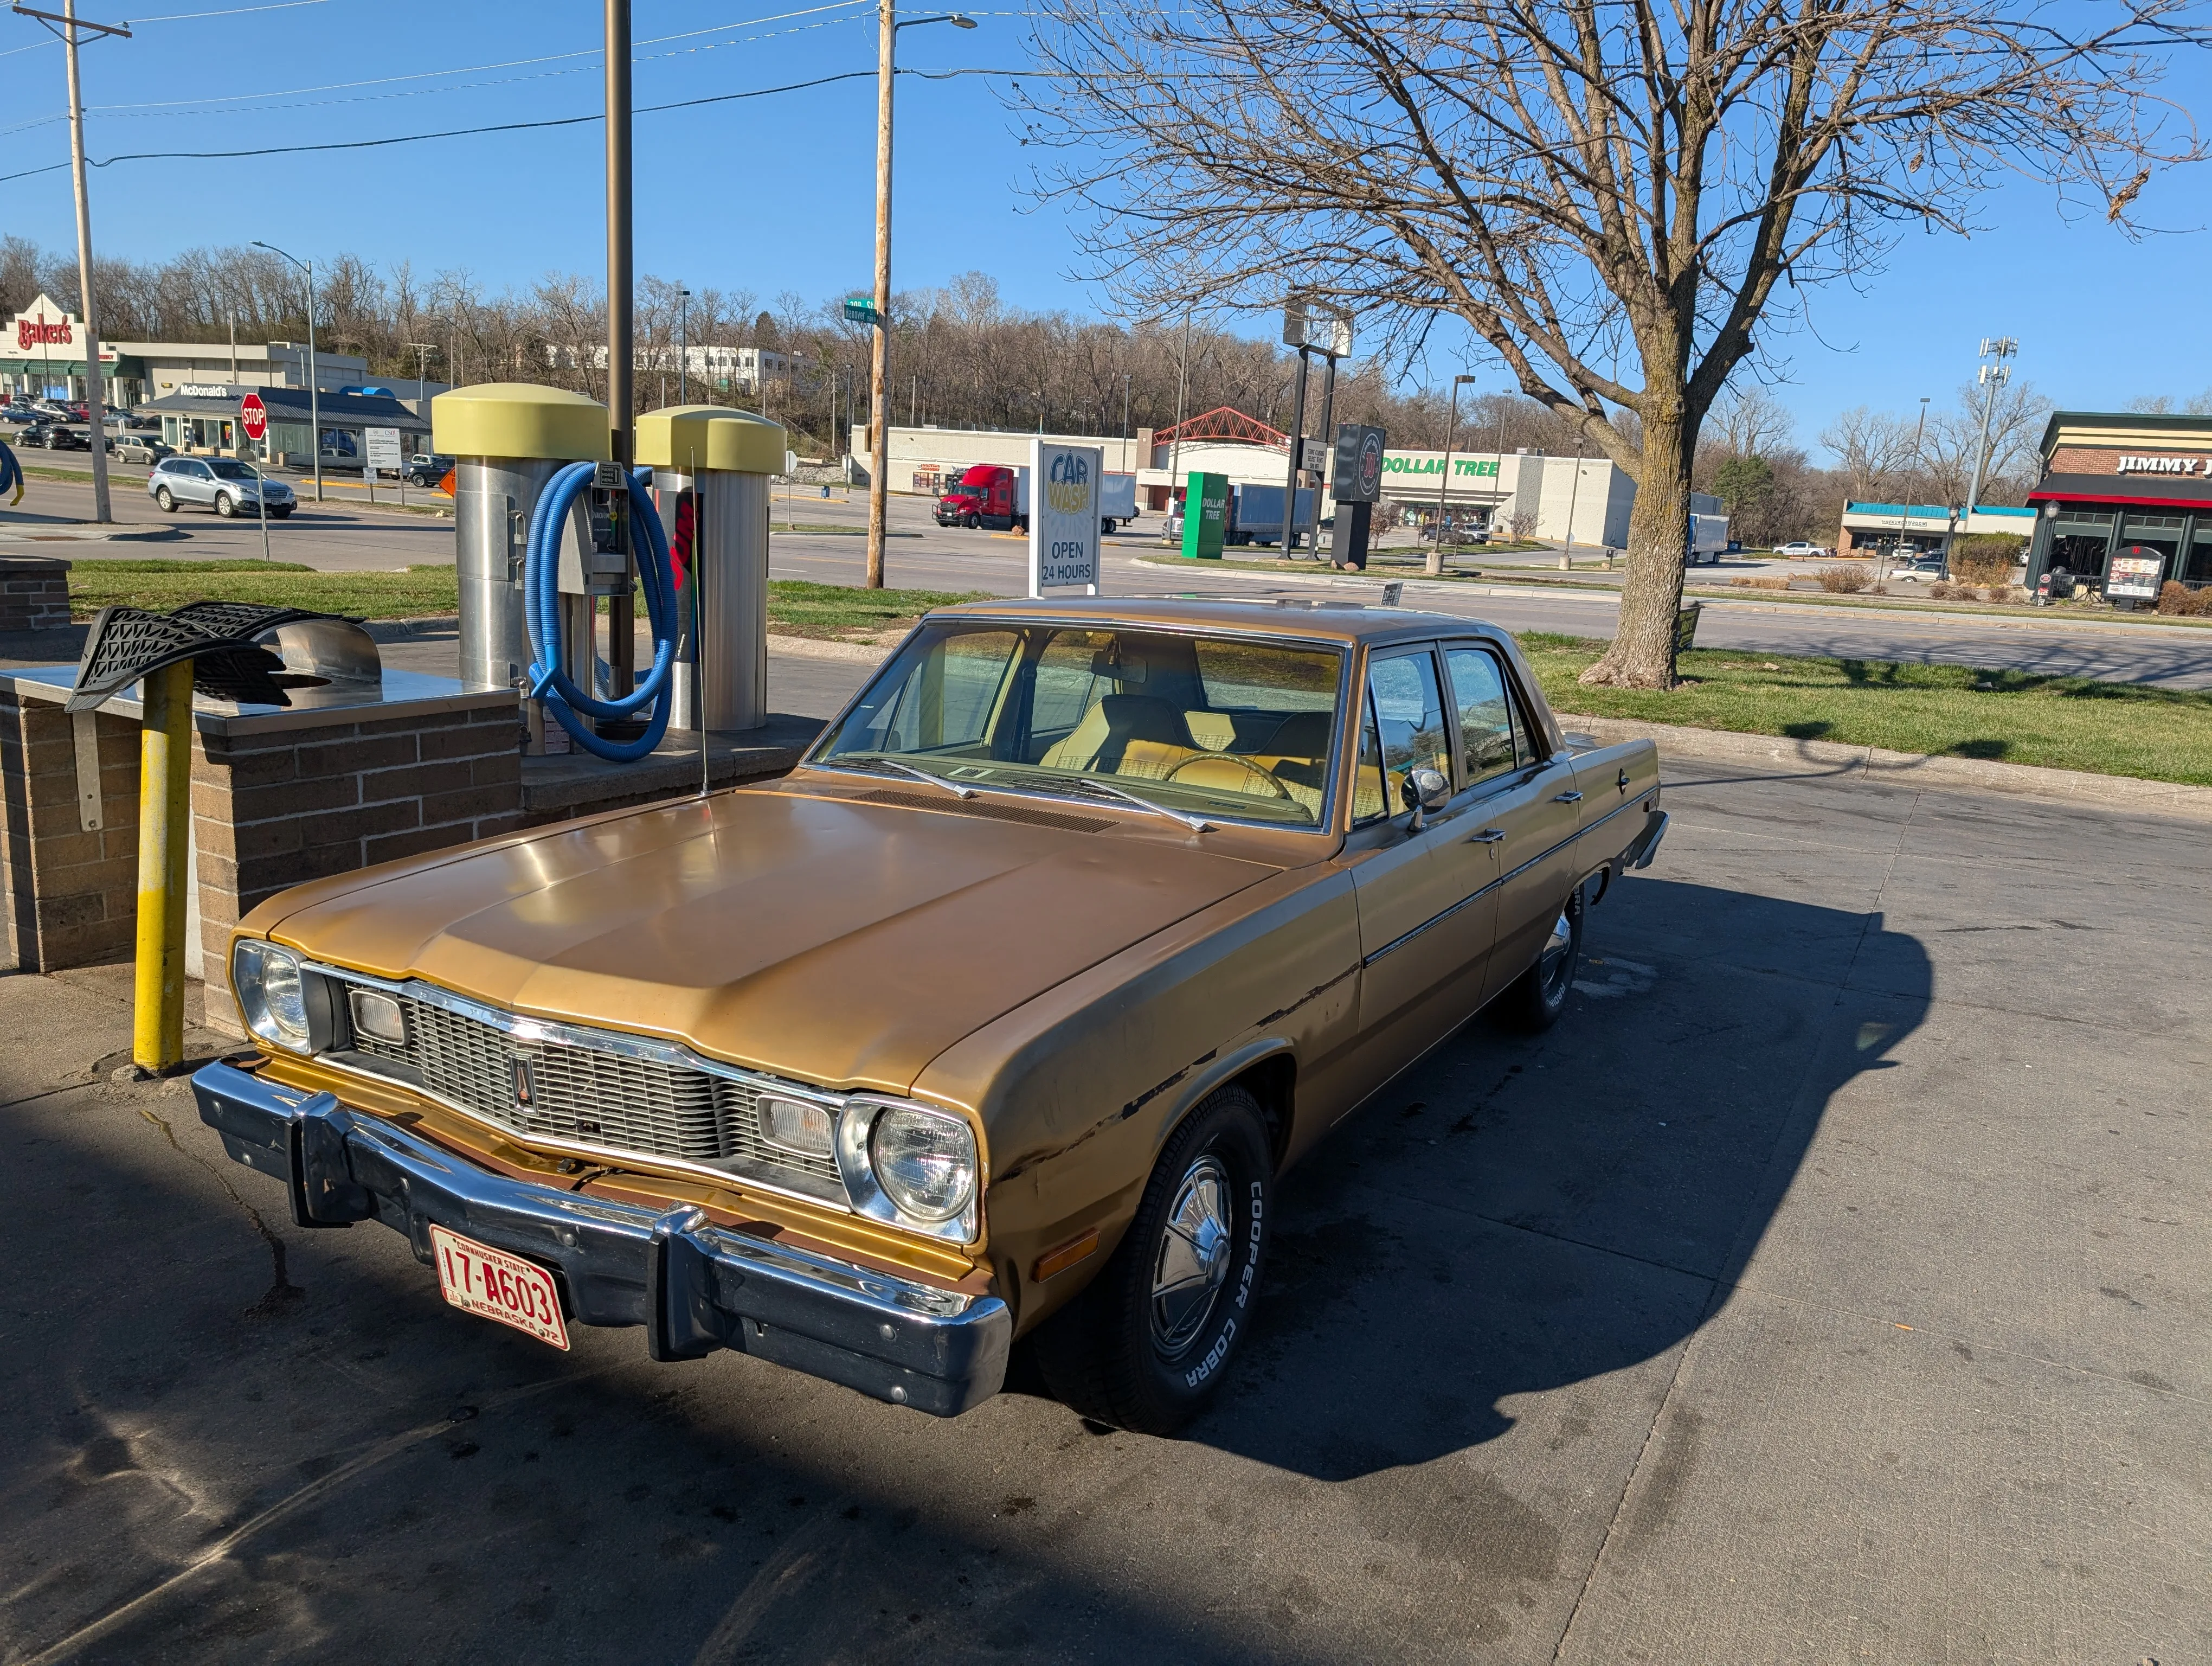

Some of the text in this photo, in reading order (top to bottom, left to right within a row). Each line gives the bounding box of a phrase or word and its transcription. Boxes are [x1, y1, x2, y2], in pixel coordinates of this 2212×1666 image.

[845, 307, 865, 320] Hanover
[17, 313, 73, 351] Baker's
[181, 385, 227, 397] McDonald's
[243, 407, 264, 425] STOP
[1050, 452, 1089, 485] CAR
[1382, 457, 1501, 477] DOLLAR TREE
[2116, 456, 2198, 472] JIMMY
[1047, 480, 1090, 514] WASH
[1202, 497, 1225, 509] DOLLAR
[1205, 510, 1220, 520] TREE
[1052, 541, 1083, 559] OPEN
[1043, 564, 1091, 580] 24 HOURS
[1235, 1181, 1262, 1309] COOPER
[439, 1244, 449, 1284] HISTORICAL
[456, 1241, 526, 1275] CORNHUSKER STATE
[471, 1298, 560, 1342] NEBRASKA 72
[1185, 1318, 1237, 1388] COBRA
